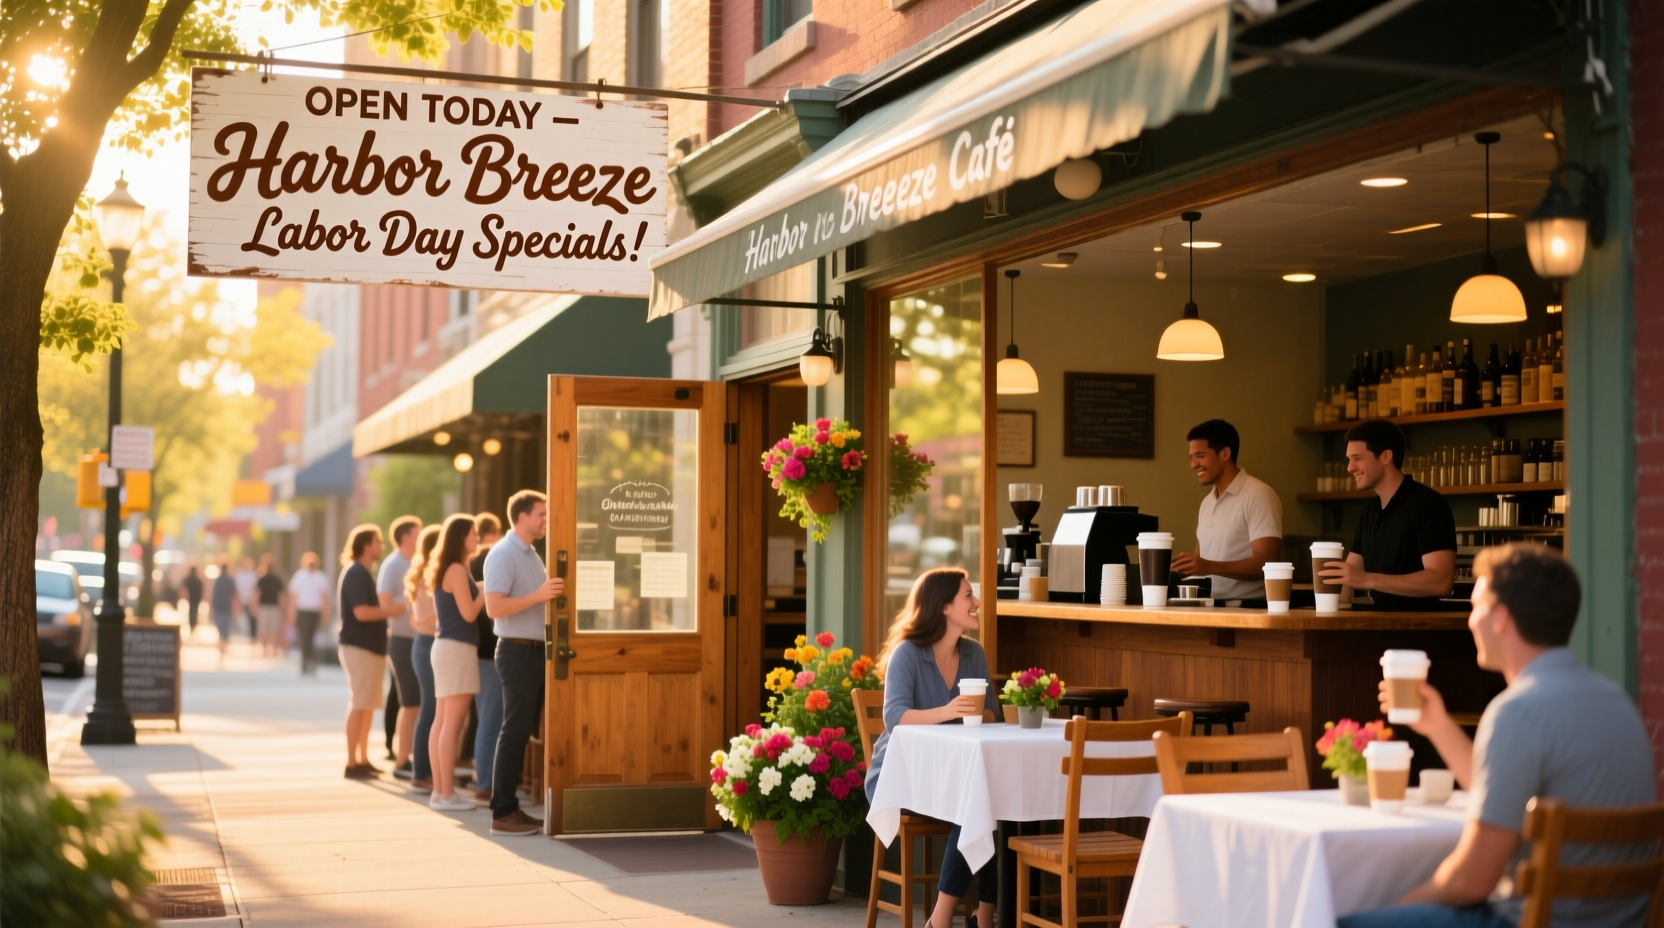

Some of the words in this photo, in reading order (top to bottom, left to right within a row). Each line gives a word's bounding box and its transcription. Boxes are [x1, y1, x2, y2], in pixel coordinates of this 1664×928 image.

[305, 85, 408, 122] OPEN
[421, 93, 543, 130] TODAY
[206, 120, 451, 203] Harbor
[460, 133, 657, 215] Breeze
[744, 212, 808, 274] Harbor
[949, 115, 1015, 191] Café
[240, 205, 372, 257] Labor
[378, 209, 465, 272] Day
[472, 213, 649, 272] Specials!
